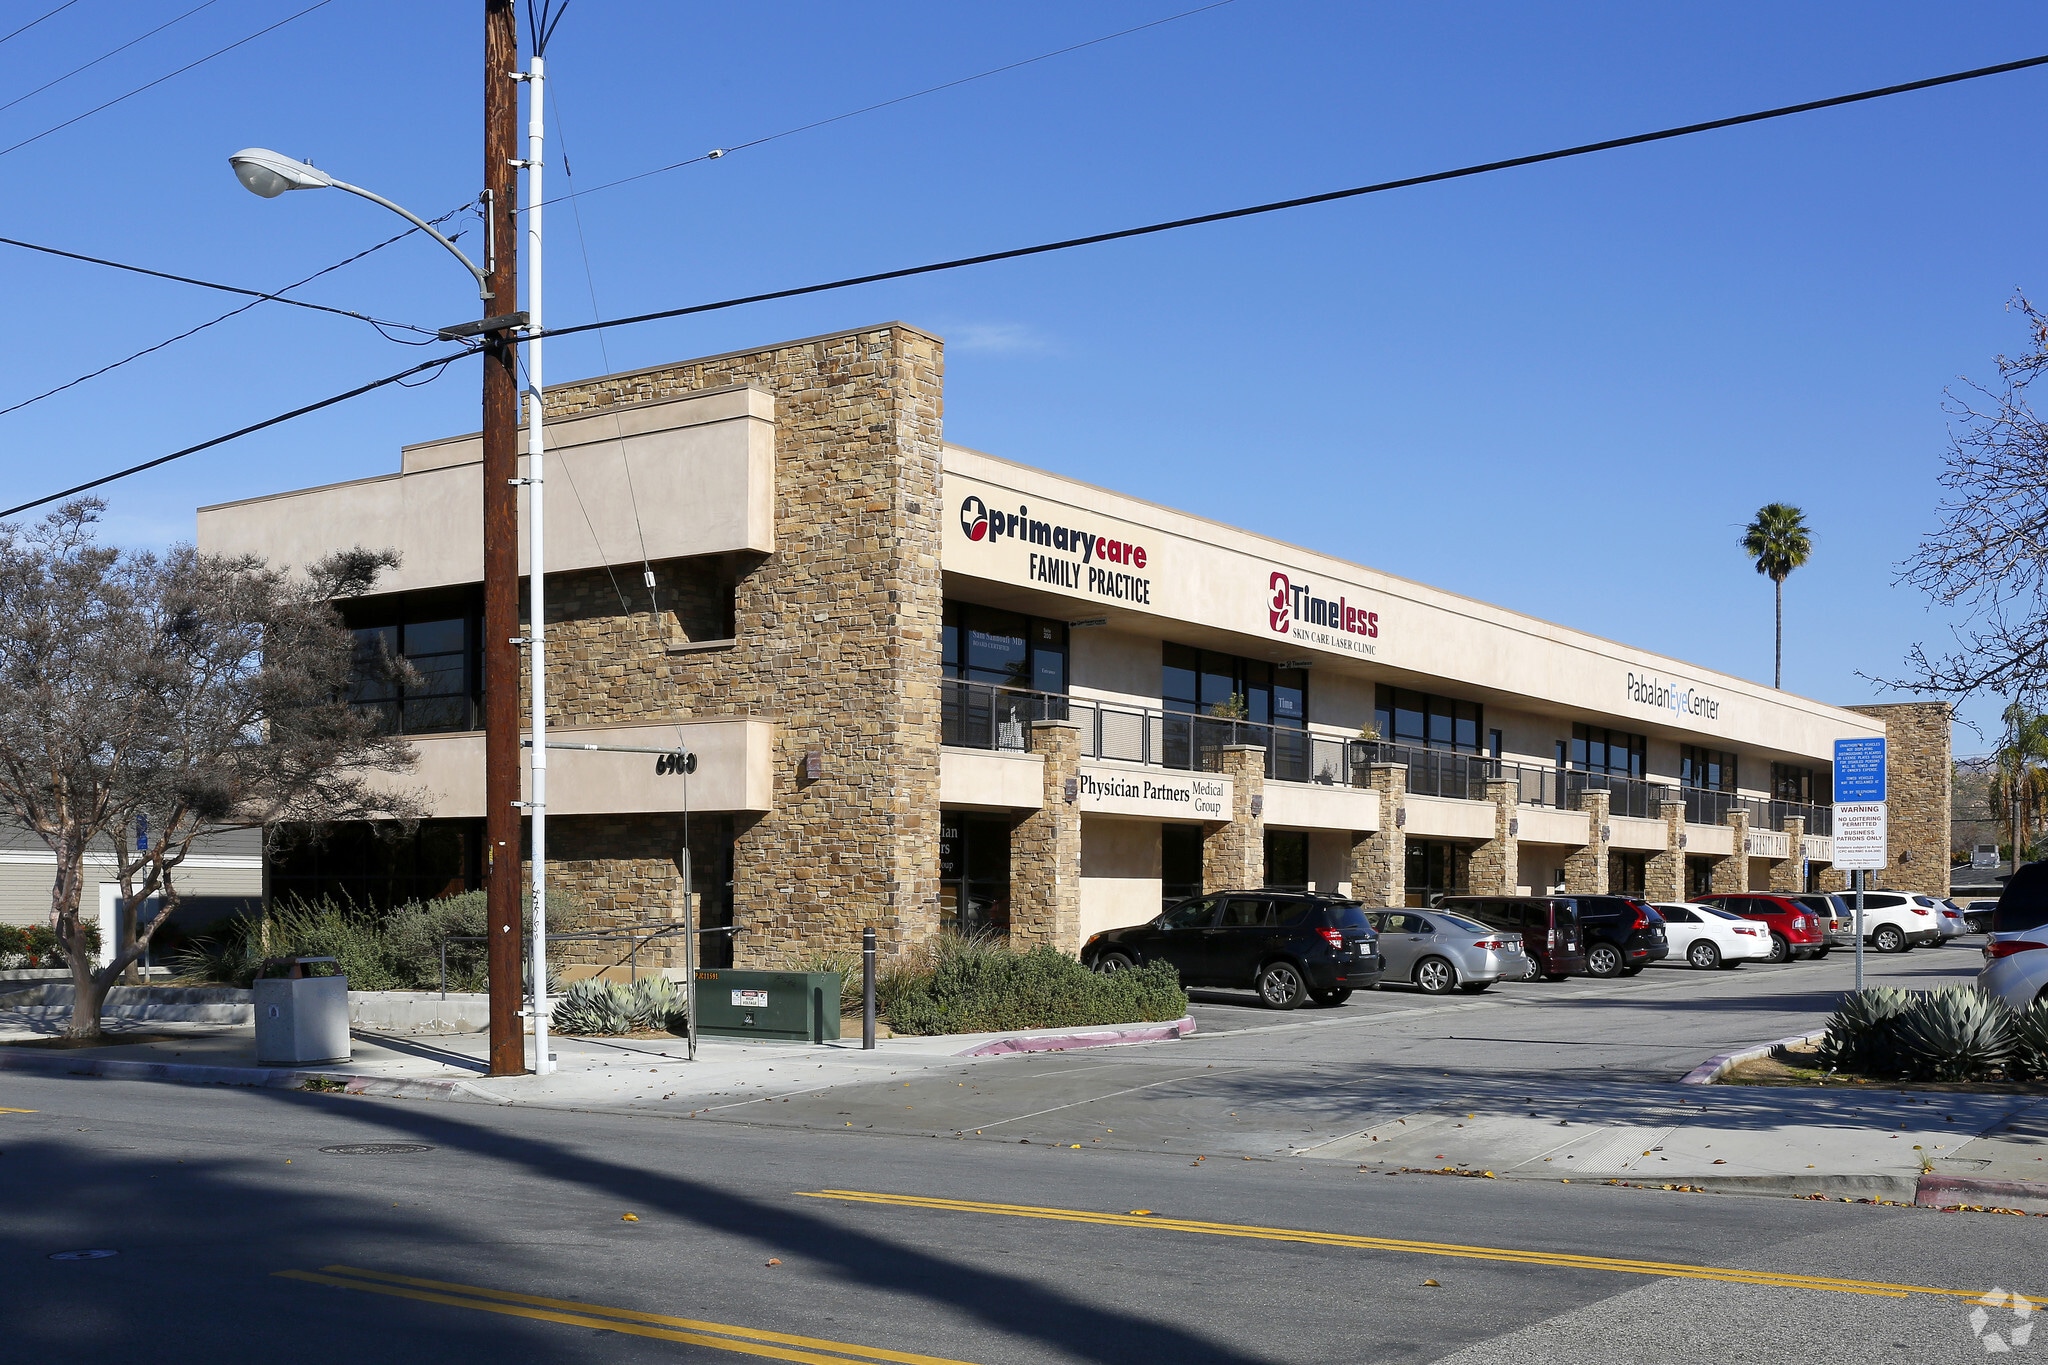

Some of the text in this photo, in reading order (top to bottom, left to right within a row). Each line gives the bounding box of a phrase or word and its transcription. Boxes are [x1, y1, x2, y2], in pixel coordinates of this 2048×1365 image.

[988, 504, 1147, 569] primarycare
[1029, 553, 1151, 605] FAMILY PRACTICE
[1290, 584, 1379, 639] Timeless
[1292, 627, 1377, 656] SKIN CARE LASER CLINIC
[1627, 672, 1720, 721] PabalanEyeCenter
[1079, 774, 1190, 802] Physician Partners
[1192, 780, 1224, 797] Medical
[1194, 798, 1221, 817] Group
